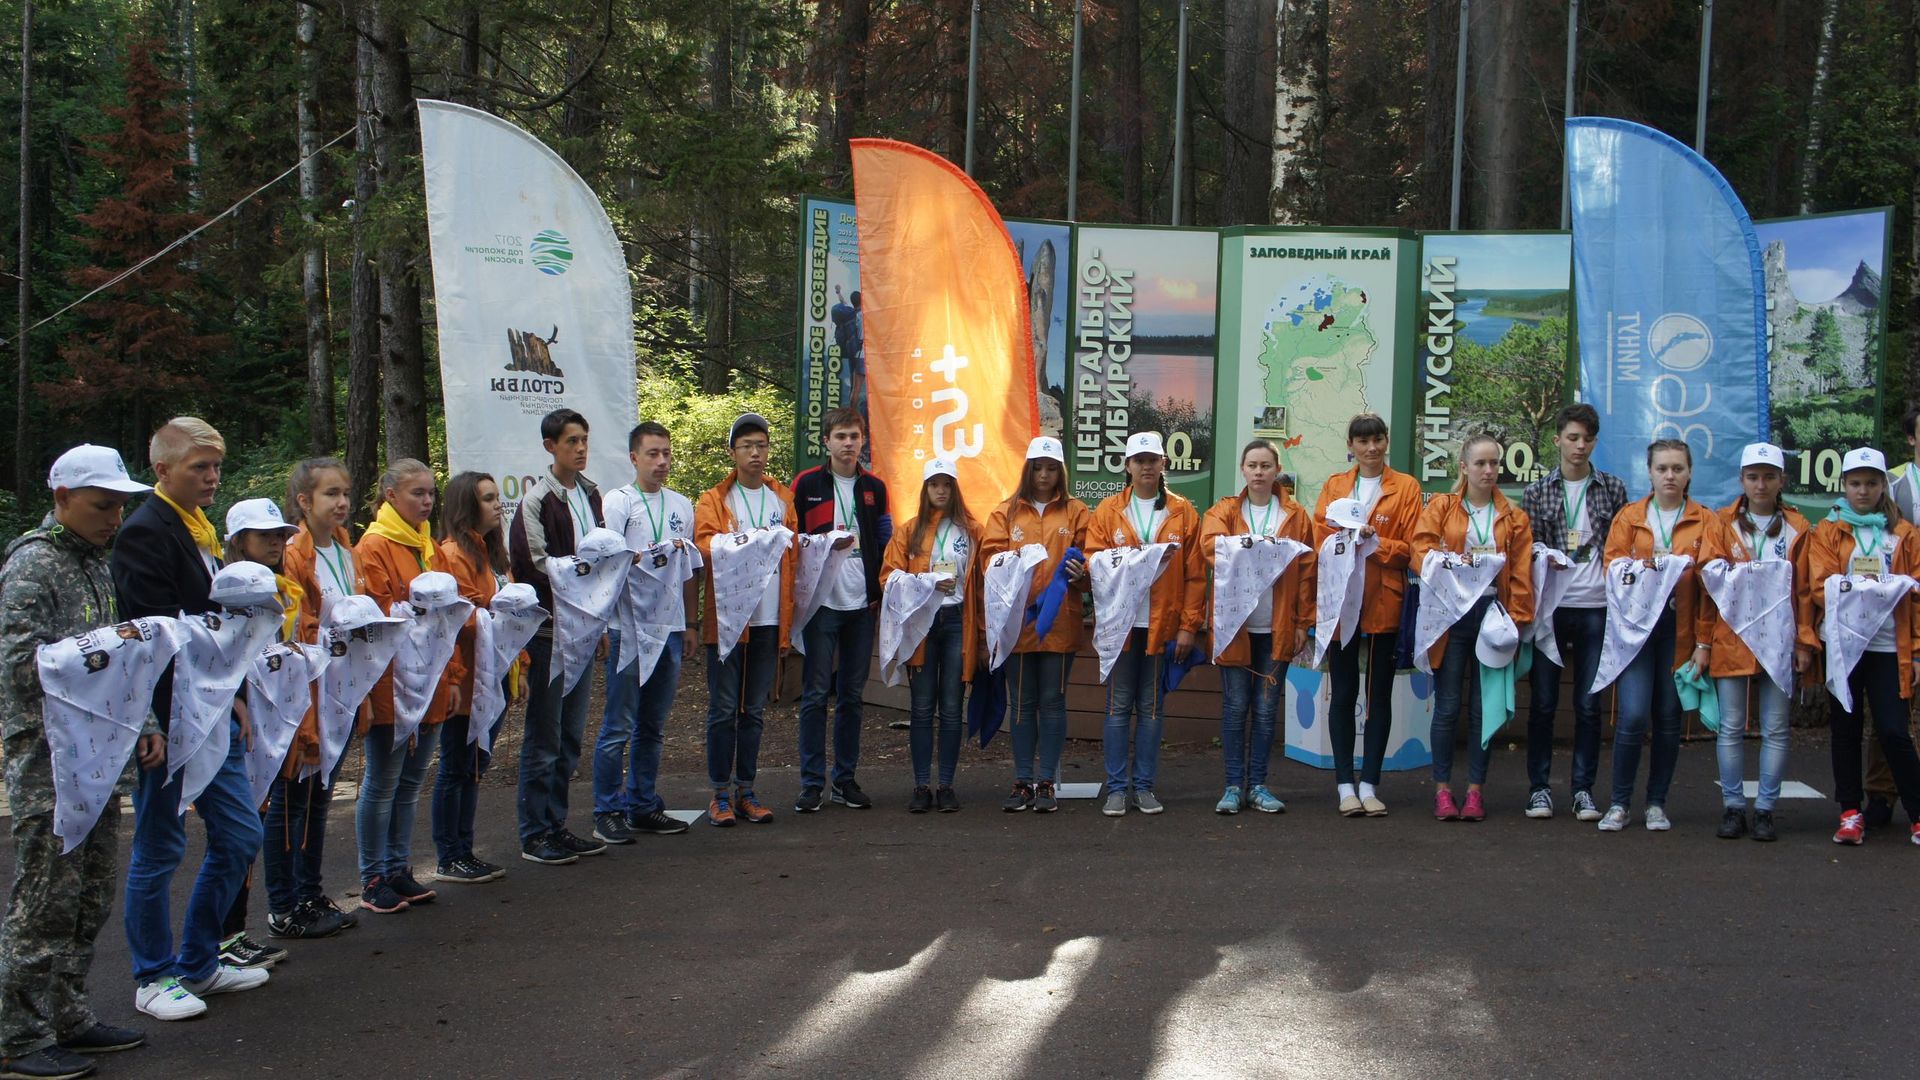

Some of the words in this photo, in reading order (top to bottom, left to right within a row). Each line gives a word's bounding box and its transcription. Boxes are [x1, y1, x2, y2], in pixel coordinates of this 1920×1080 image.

[811, 208, 828, 322] СОЗВЕЗДИЕ
[1250, 246, 1347, 260] ЗАПОВЕДНЫЙ
[1351, 247, 1390, 260] КРАЙ
[807, 327, 824, 457] ЗАПОВЕДНОЕ
[1076, 248, 1106, 473] ЦЕНТРАЛЬНО-
[1104, 270, 1134, 474] СИБИРСКИЙ
[1423, 256, 1457, 482] ТУНГУССКИЙ
[1075, 481, 1127, 491] БИОСФЕР
[1170, 459, 1201, 471] ЛЕТ
